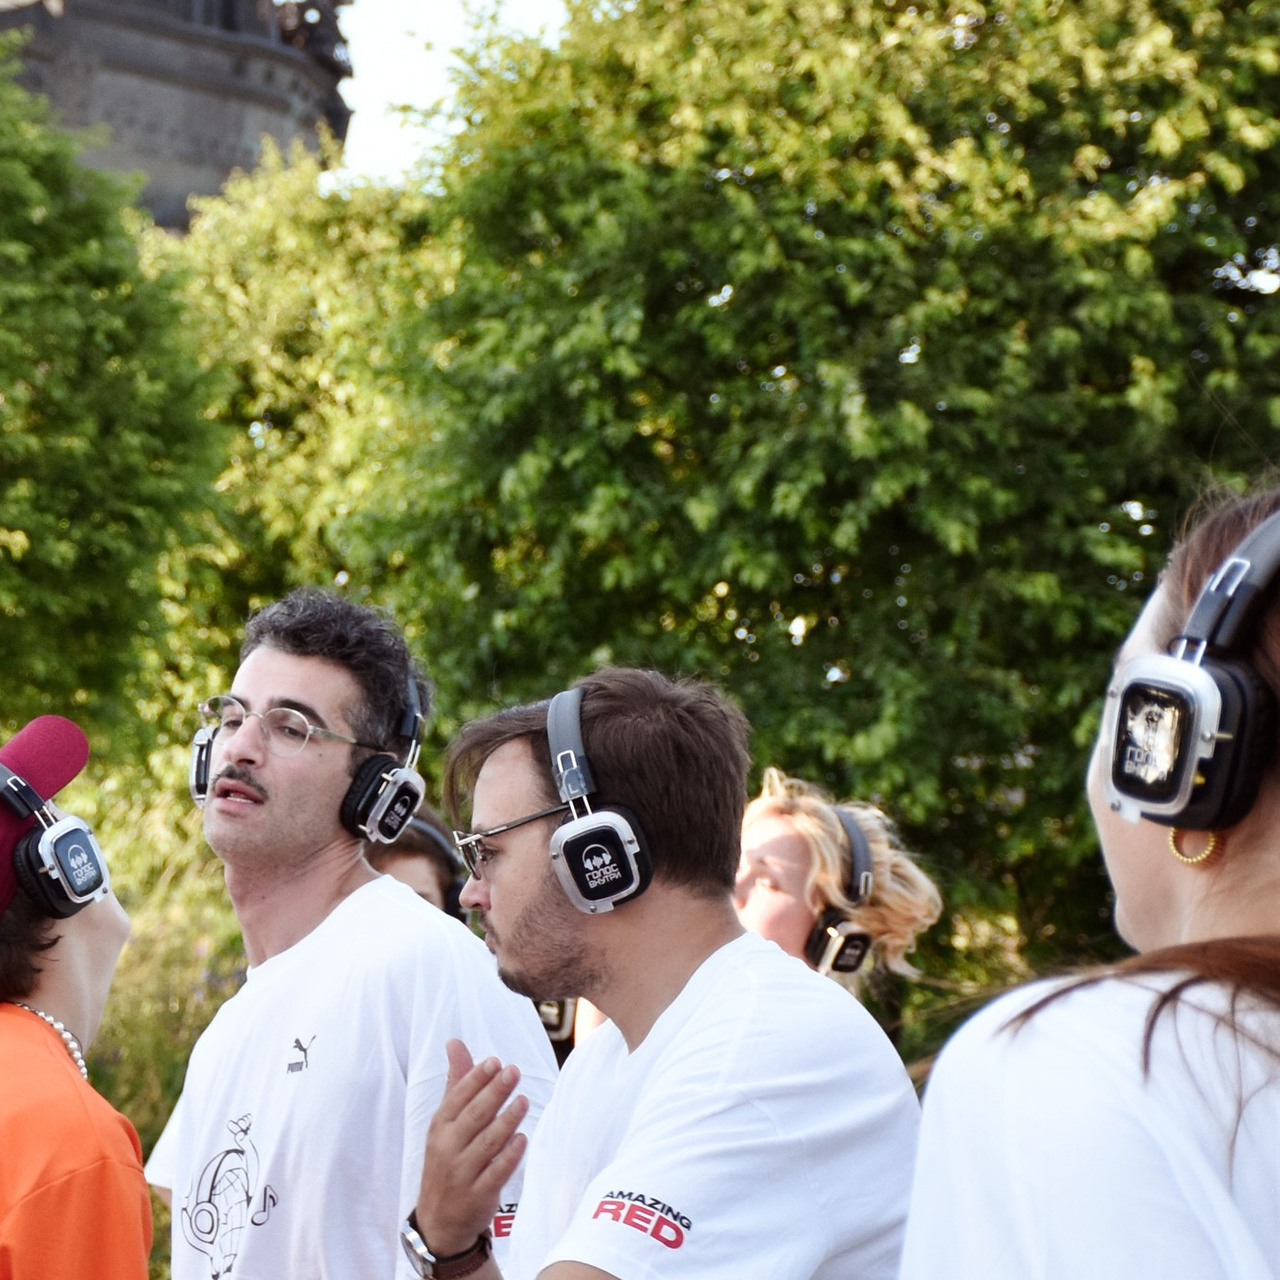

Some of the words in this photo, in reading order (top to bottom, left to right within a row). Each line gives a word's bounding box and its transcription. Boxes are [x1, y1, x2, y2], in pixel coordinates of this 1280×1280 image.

[585, 863, 619, 881] ГОЛОС
[588, 871, 622, 889] ВНУТРИ
[592, 1200, 684, 1250] RED
[603, 1190, 692, 1231] AMAZING
